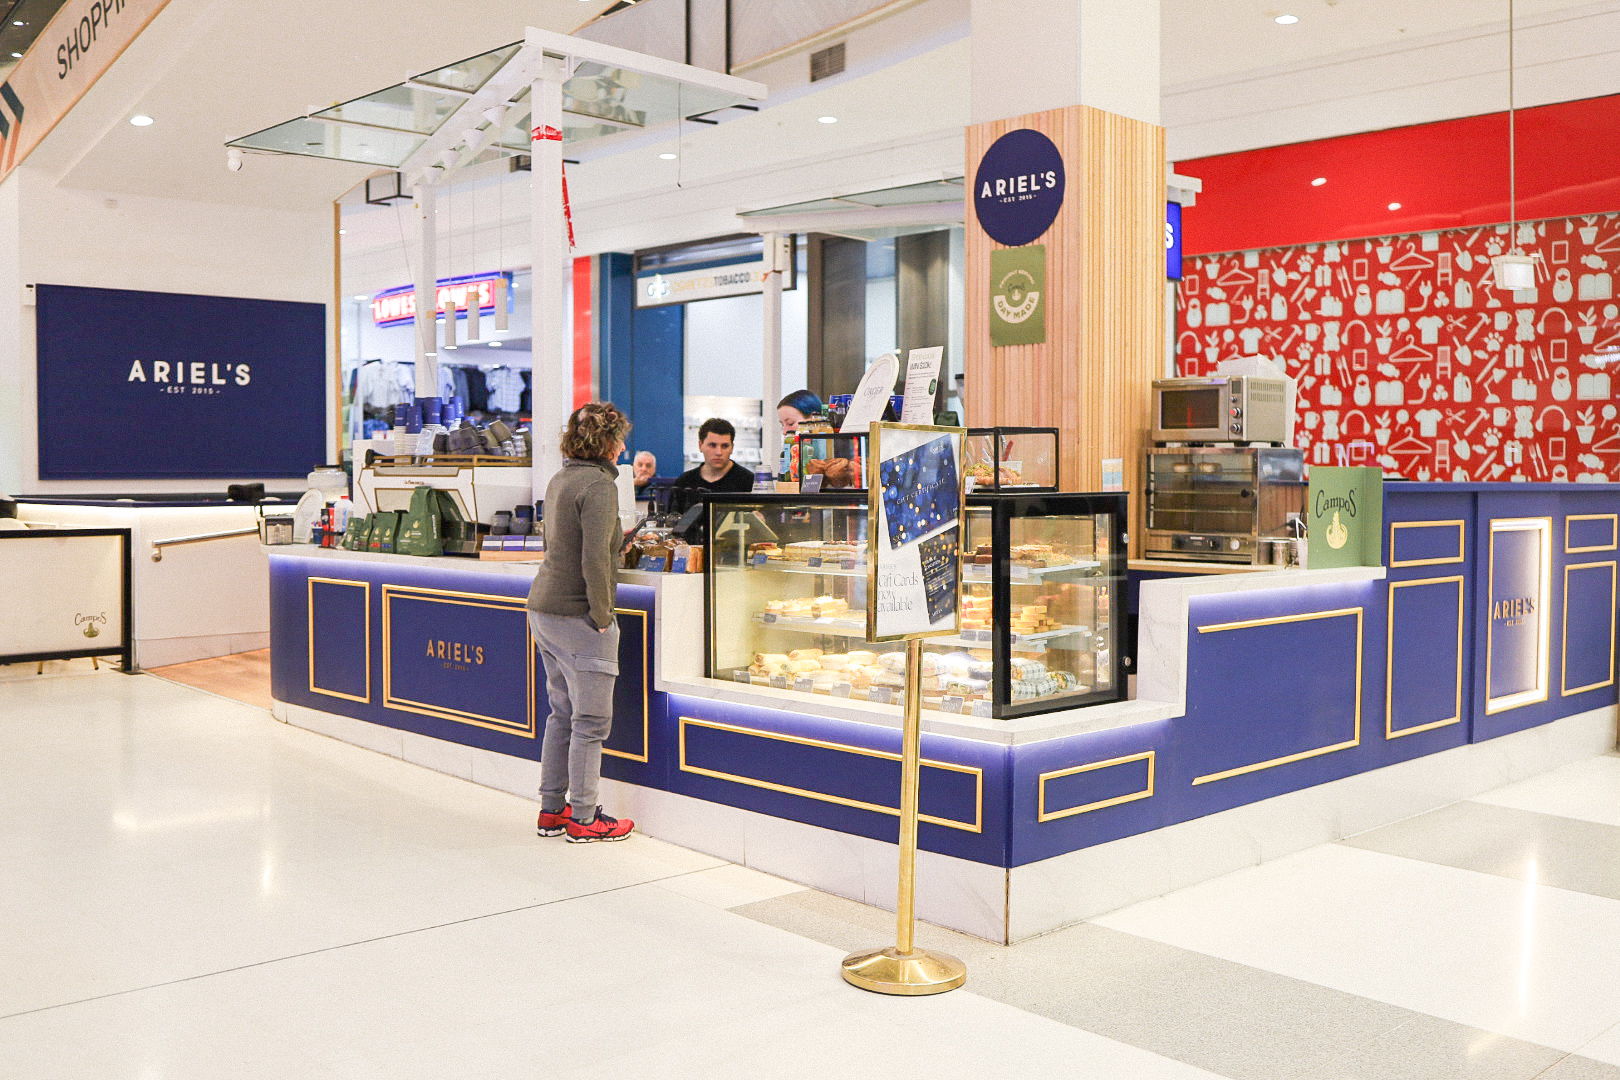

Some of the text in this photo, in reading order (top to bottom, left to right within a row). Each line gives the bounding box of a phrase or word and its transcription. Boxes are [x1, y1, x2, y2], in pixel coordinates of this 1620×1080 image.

[980, 170, 1056, 199] ARIEL'S
[714, 271, 750, 287] TOBACCO
[997, 297, 1036, 319] DAY MADE
[128, 359, 251, 386] ARIEL'S
[894, 571, 919, 588] Cards
[876, 596, 913, 613] available
[426, 638, 484, 665] ARIEL'S
